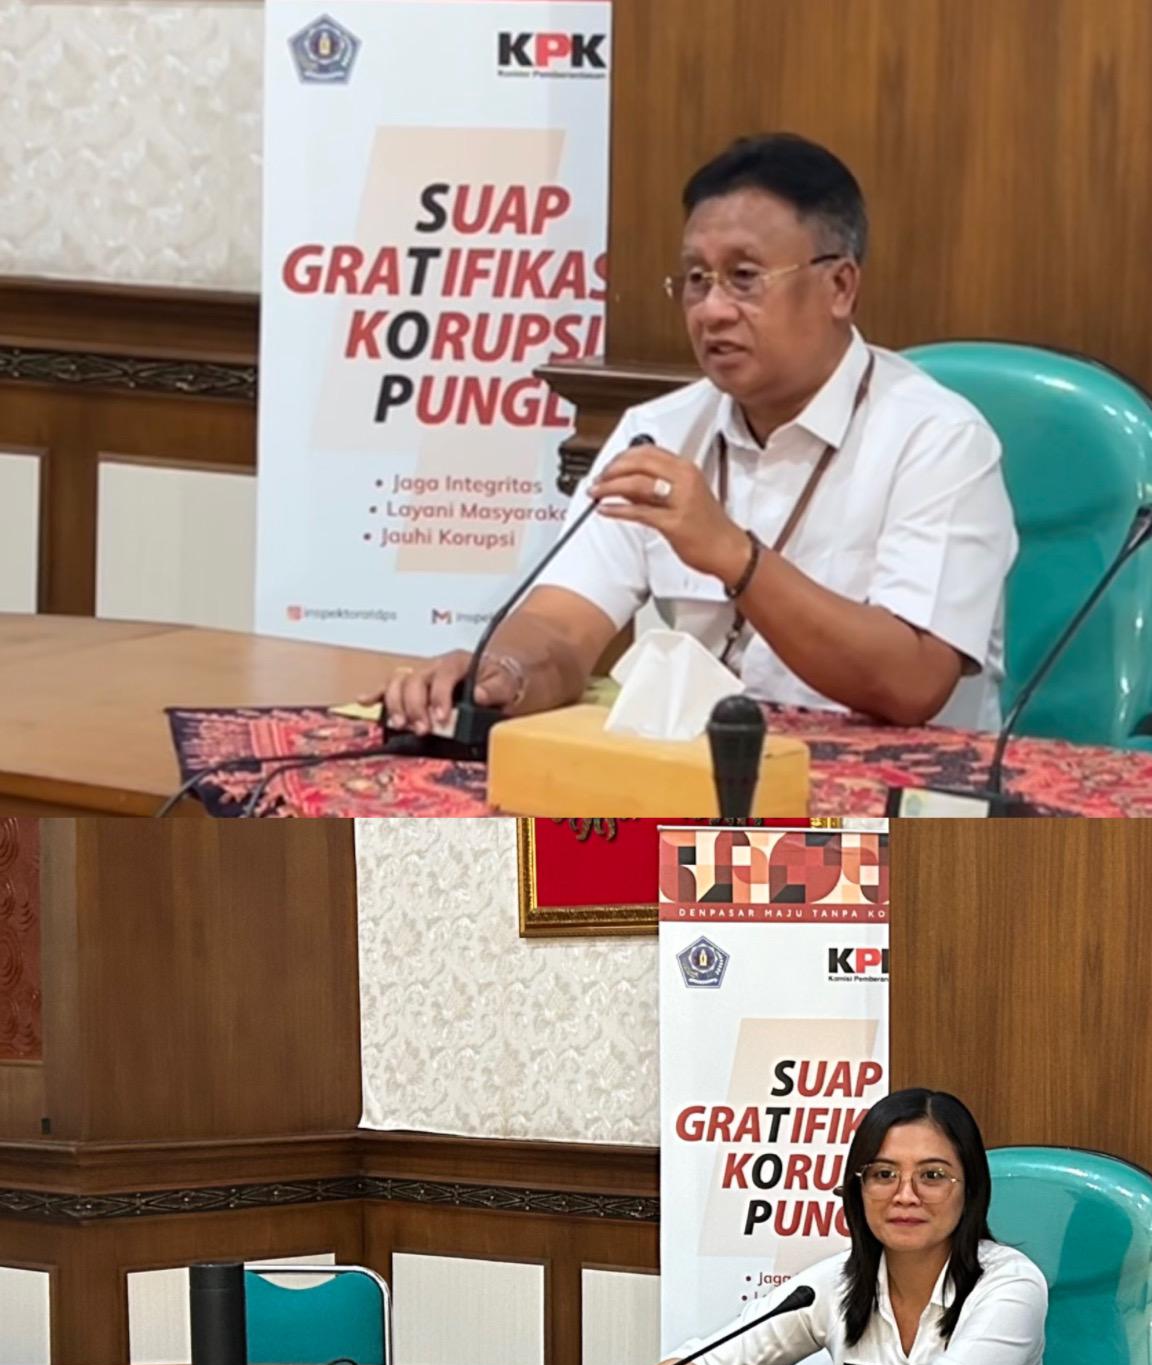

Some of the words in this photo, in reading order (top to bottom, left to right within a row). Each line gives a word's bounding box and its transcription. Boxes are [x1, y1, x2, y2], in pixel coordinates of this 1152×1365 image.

[498, 32, 606, 68] KPK
[415, 183, 571, 235] SUAP
[345, 310, 604, 362] KORUPSI
[374, 374, 574, 427] PUNGL
[392, 475, 439, 494] Jaga
[445, 476, 543, 497] Integritas
[387, 502, 454, 521] Layani
[380, 528, 432, 547] Jauhi
[439, 529, 515, 549] Korupsi
[678, 908, 755, 918] DENPASAR
[764, 908, 803, 918] MAJU
[812, 909, 858, 918] TANPA
[867, 909, 886, 919] KO
[770, 1060, 883, 1098] SUAP
[722, 1153, 843, 1190] KORU
